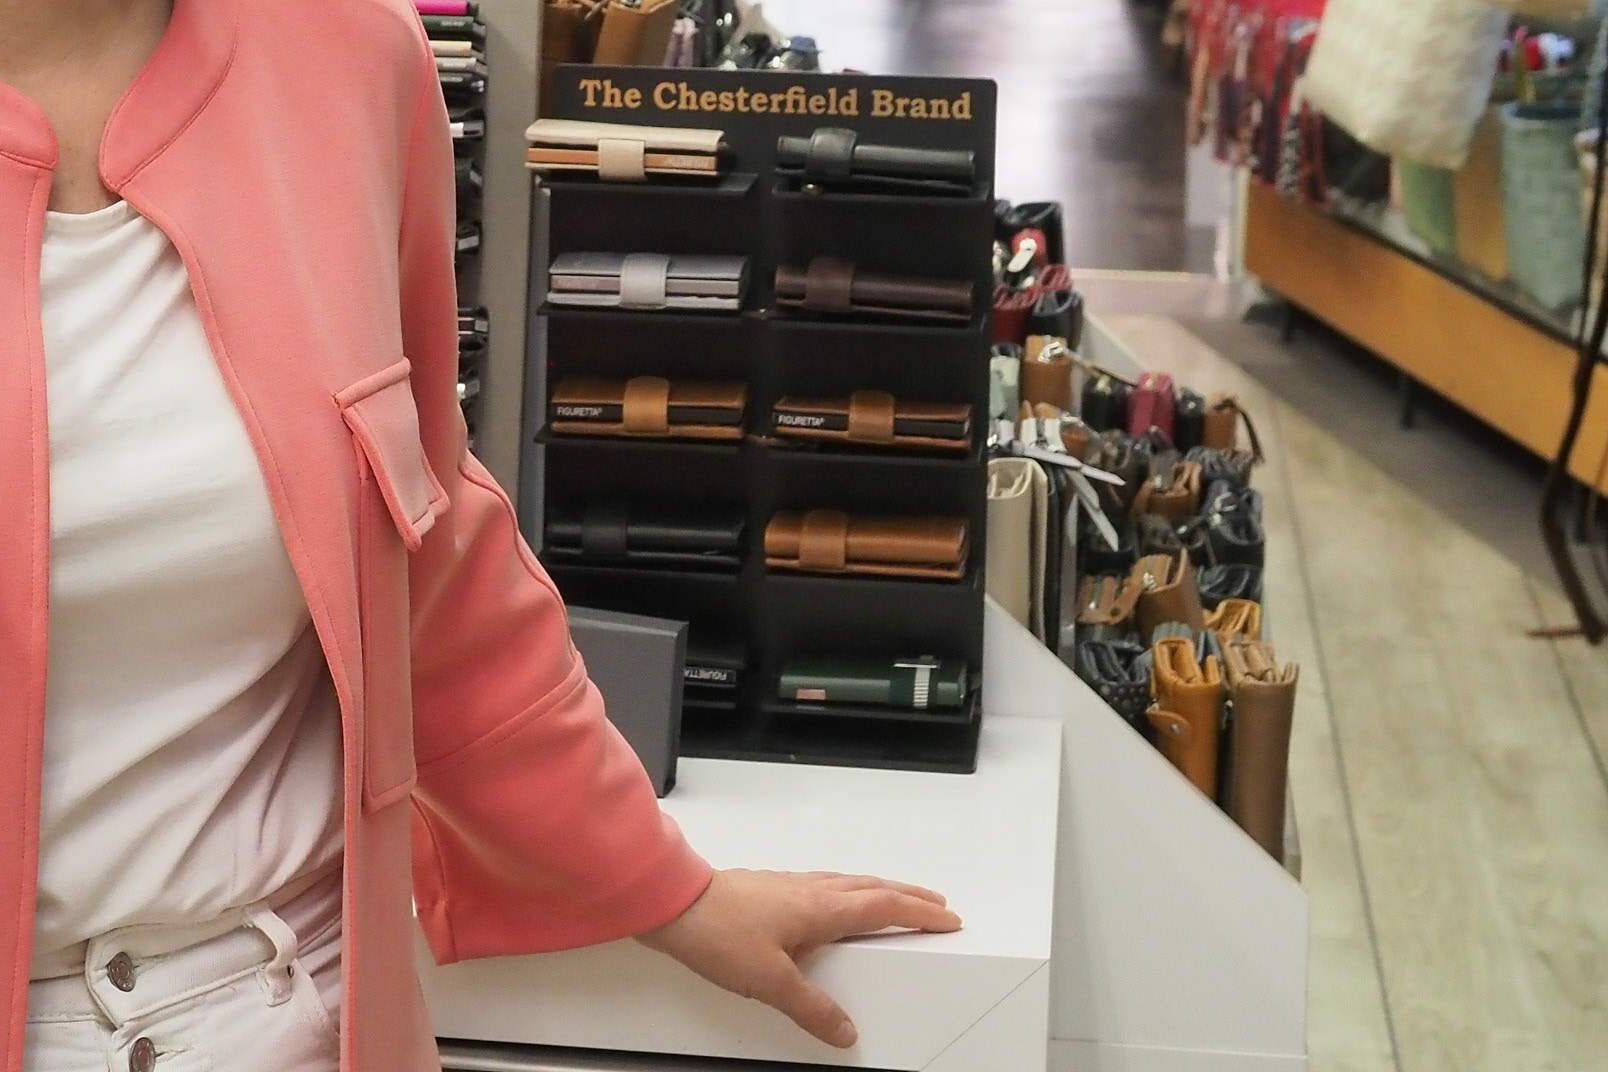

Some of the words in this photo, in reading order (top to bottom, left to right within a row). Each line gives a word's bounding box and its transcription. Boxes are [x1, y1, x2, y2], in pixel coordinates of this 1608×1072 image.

[579, 79, 642, 109] The
[652, 80, 859, 116] Chesterfield
[870, 89, 973, 120] Brand
